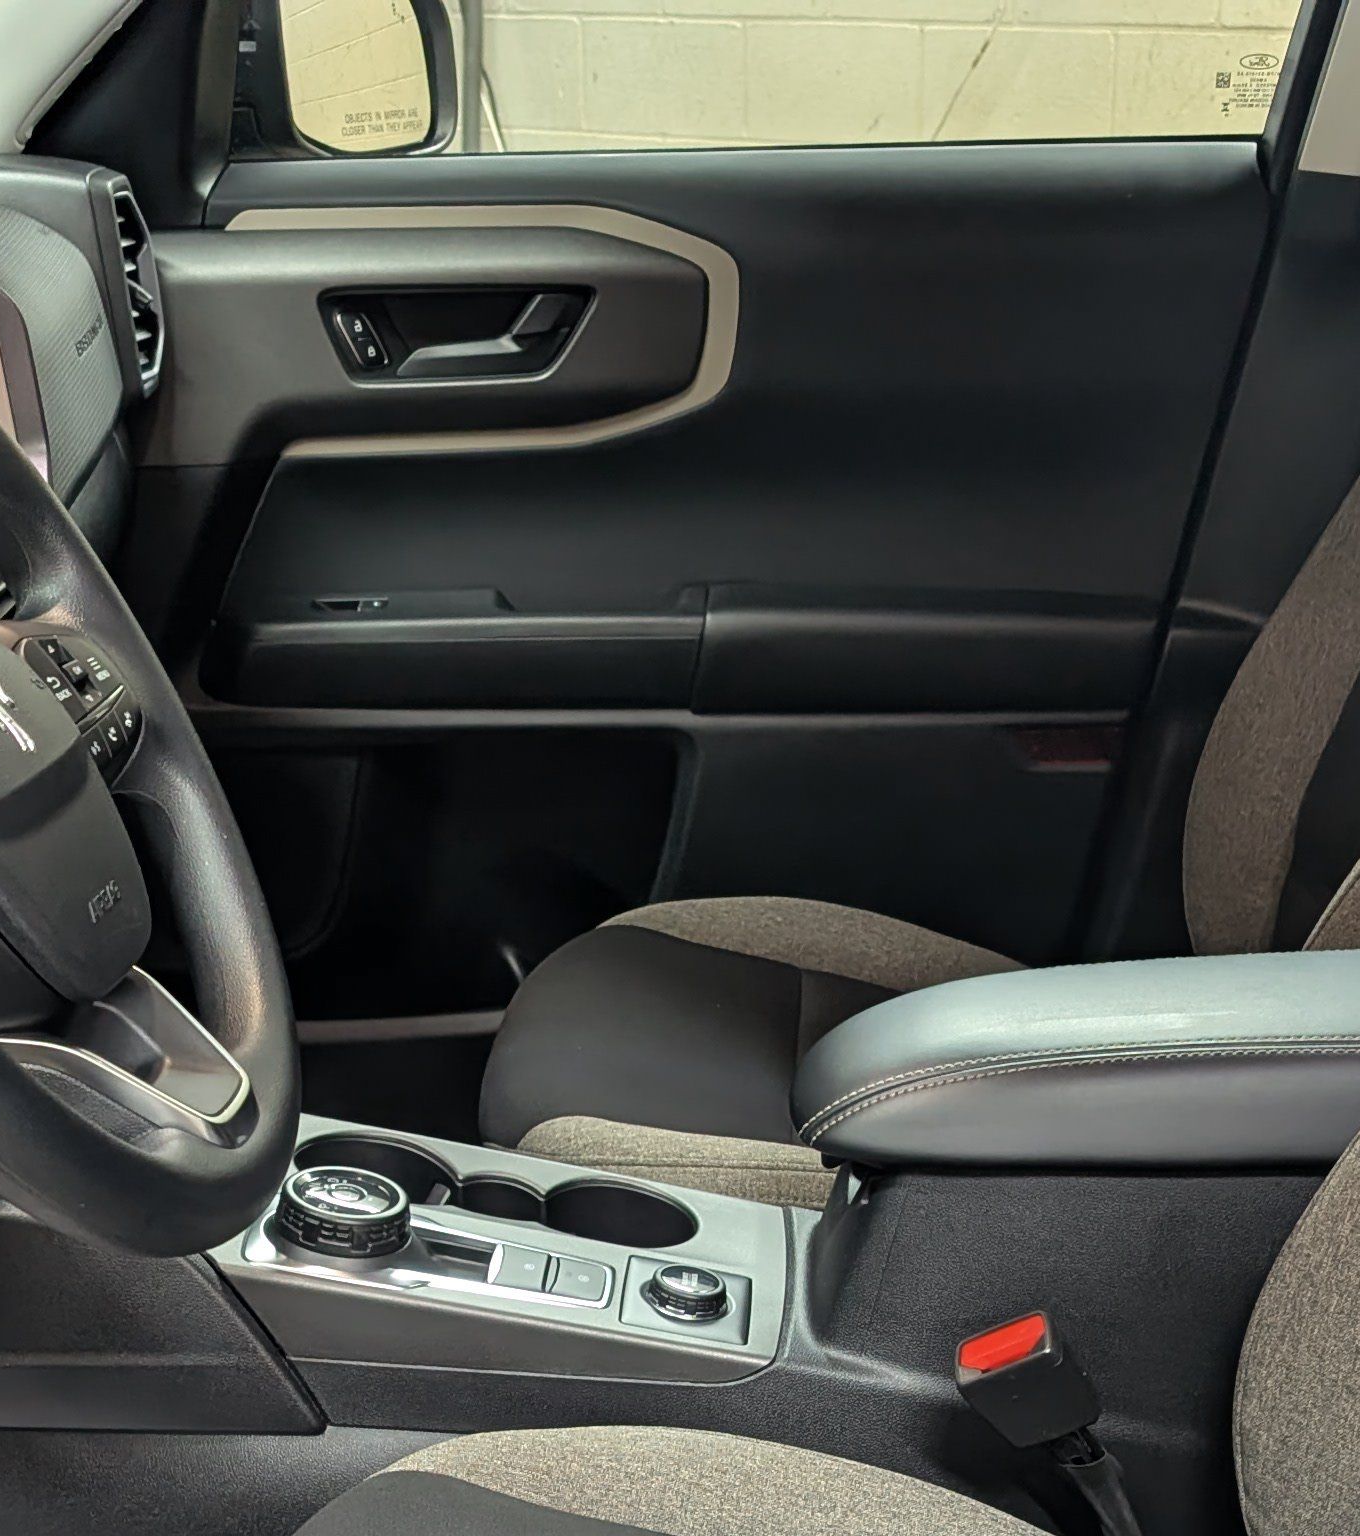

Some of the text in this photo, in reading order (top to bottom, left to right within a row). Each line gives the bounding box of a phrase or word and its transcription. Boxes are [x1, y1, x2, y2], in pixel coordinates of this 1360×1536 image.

[344, 111, 372, 124] OBJECTS
[375, 111, 382, 121] IN
[384, 109, 407, 120] MIRROR
[341, 125, 366, 137] CLOSER
[368, 124, 384, 133] THAN
[385, 122, 400, 132] THEY
